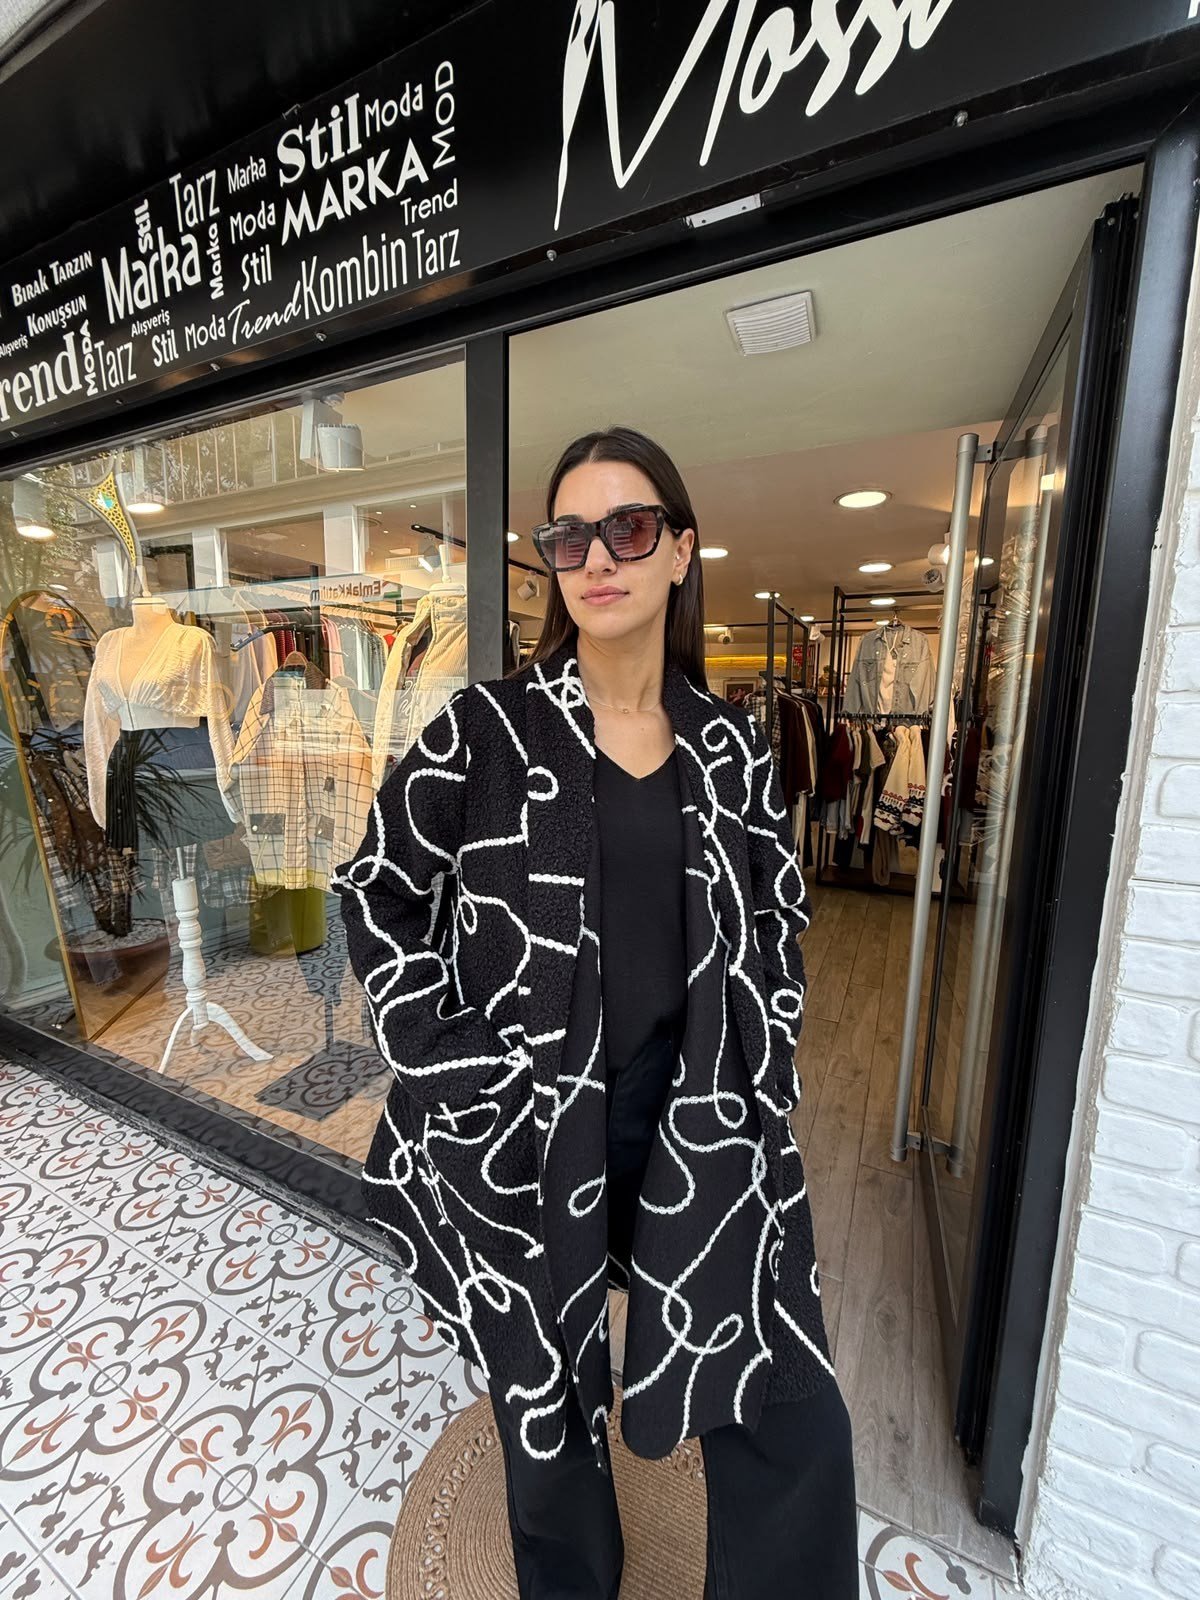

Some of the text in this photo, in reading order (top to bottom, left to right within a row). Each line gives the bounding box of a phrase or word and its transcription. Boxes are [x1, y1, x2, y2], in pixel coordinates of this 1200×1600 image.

[365, 82, 423, 137] Moda
[432, 61, 455, 169] MOD
[277, 93, 362, 187] Stil
[169, 169, 220, 233] Tarz
[227, 156, 266, 194] Marka
[282, 138, 429, 245] MARKA
[400, 178, 458, 225] Trend
[230, 201, 276, 244] Moda
[102, 226, 201, 324] Marka
[206, 222, 224, 300] Marka
[241, 243, 273, 291] Stil
[301, 233, 408, 320] Kombin
[412, 229, 460, 279] Tarz
[131, 309, 170, 337] Alışveriş
[185, 314, 226, 351] Moda
[228, 279, 302, 345] Trend
[80, 318, 98, 397] MODA
[94, 341, 137, 391] Tarz
[151, 328, 179, 367] Stil
